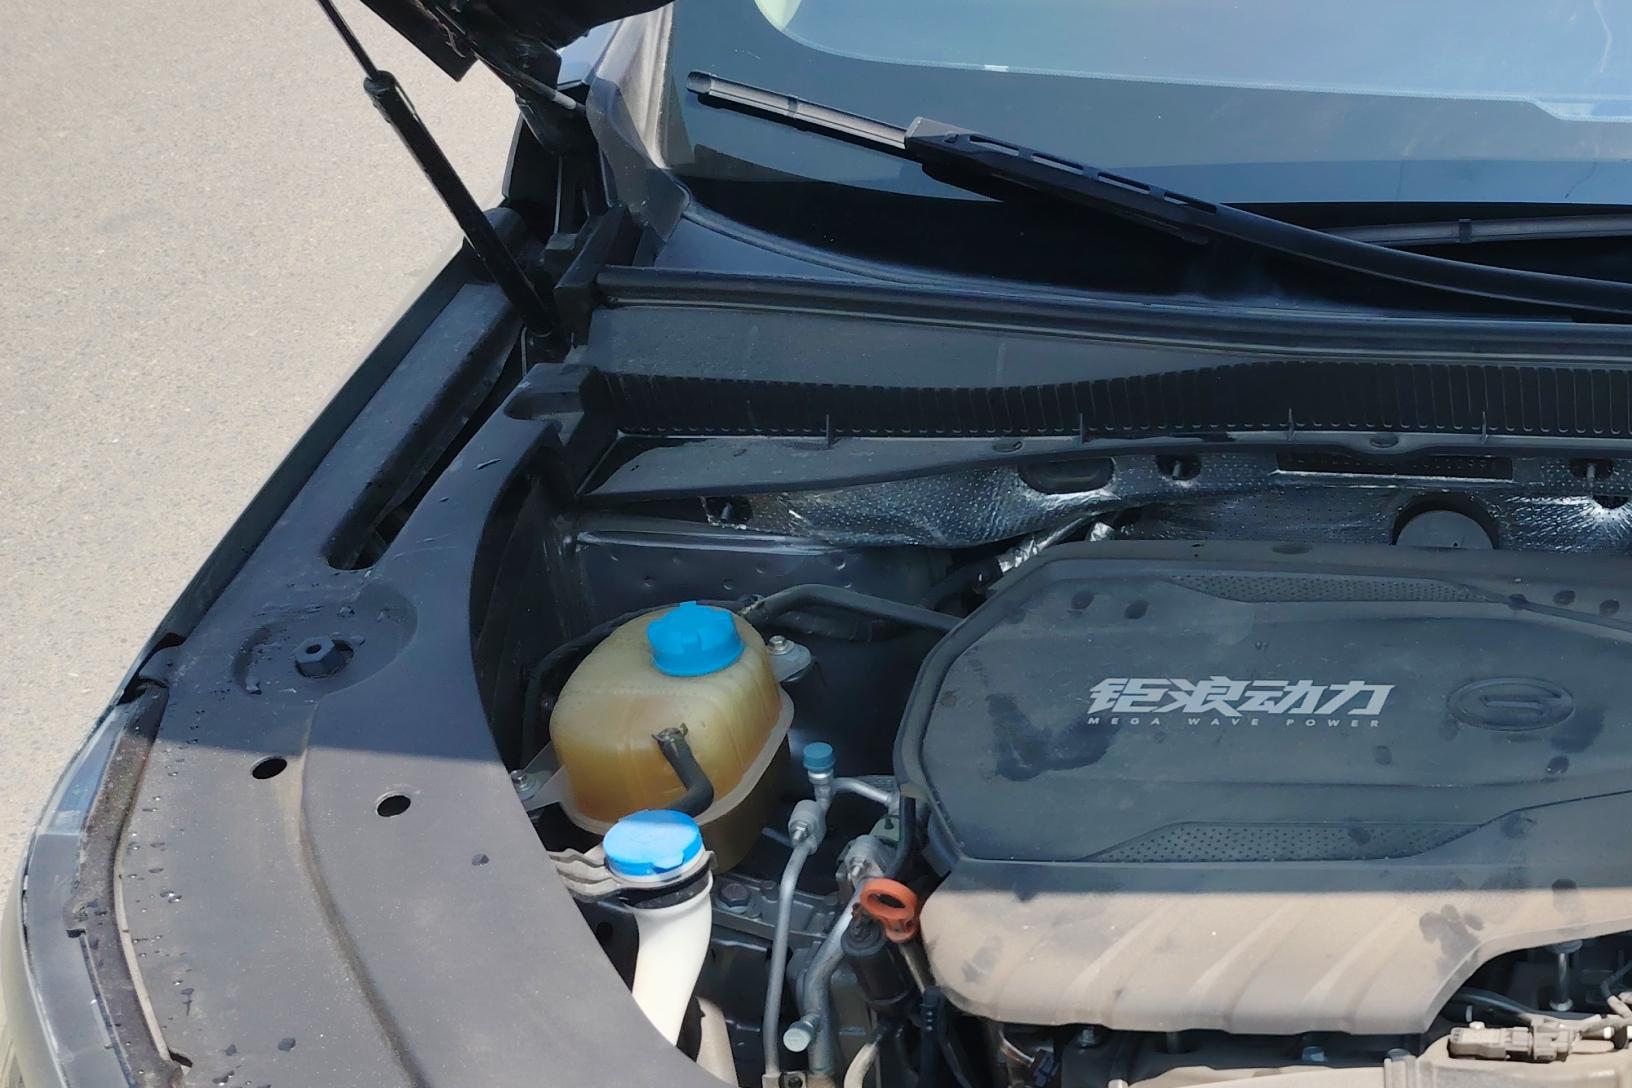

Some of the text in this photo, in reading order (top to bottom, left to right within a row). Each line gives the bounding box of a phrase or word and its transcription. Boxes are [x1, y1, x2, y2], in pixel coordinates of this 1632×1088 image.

[1087, 676, 1396, 717] 钜浪动力
[1087, 717, 1381, 728] MEGA WAVE POWER
